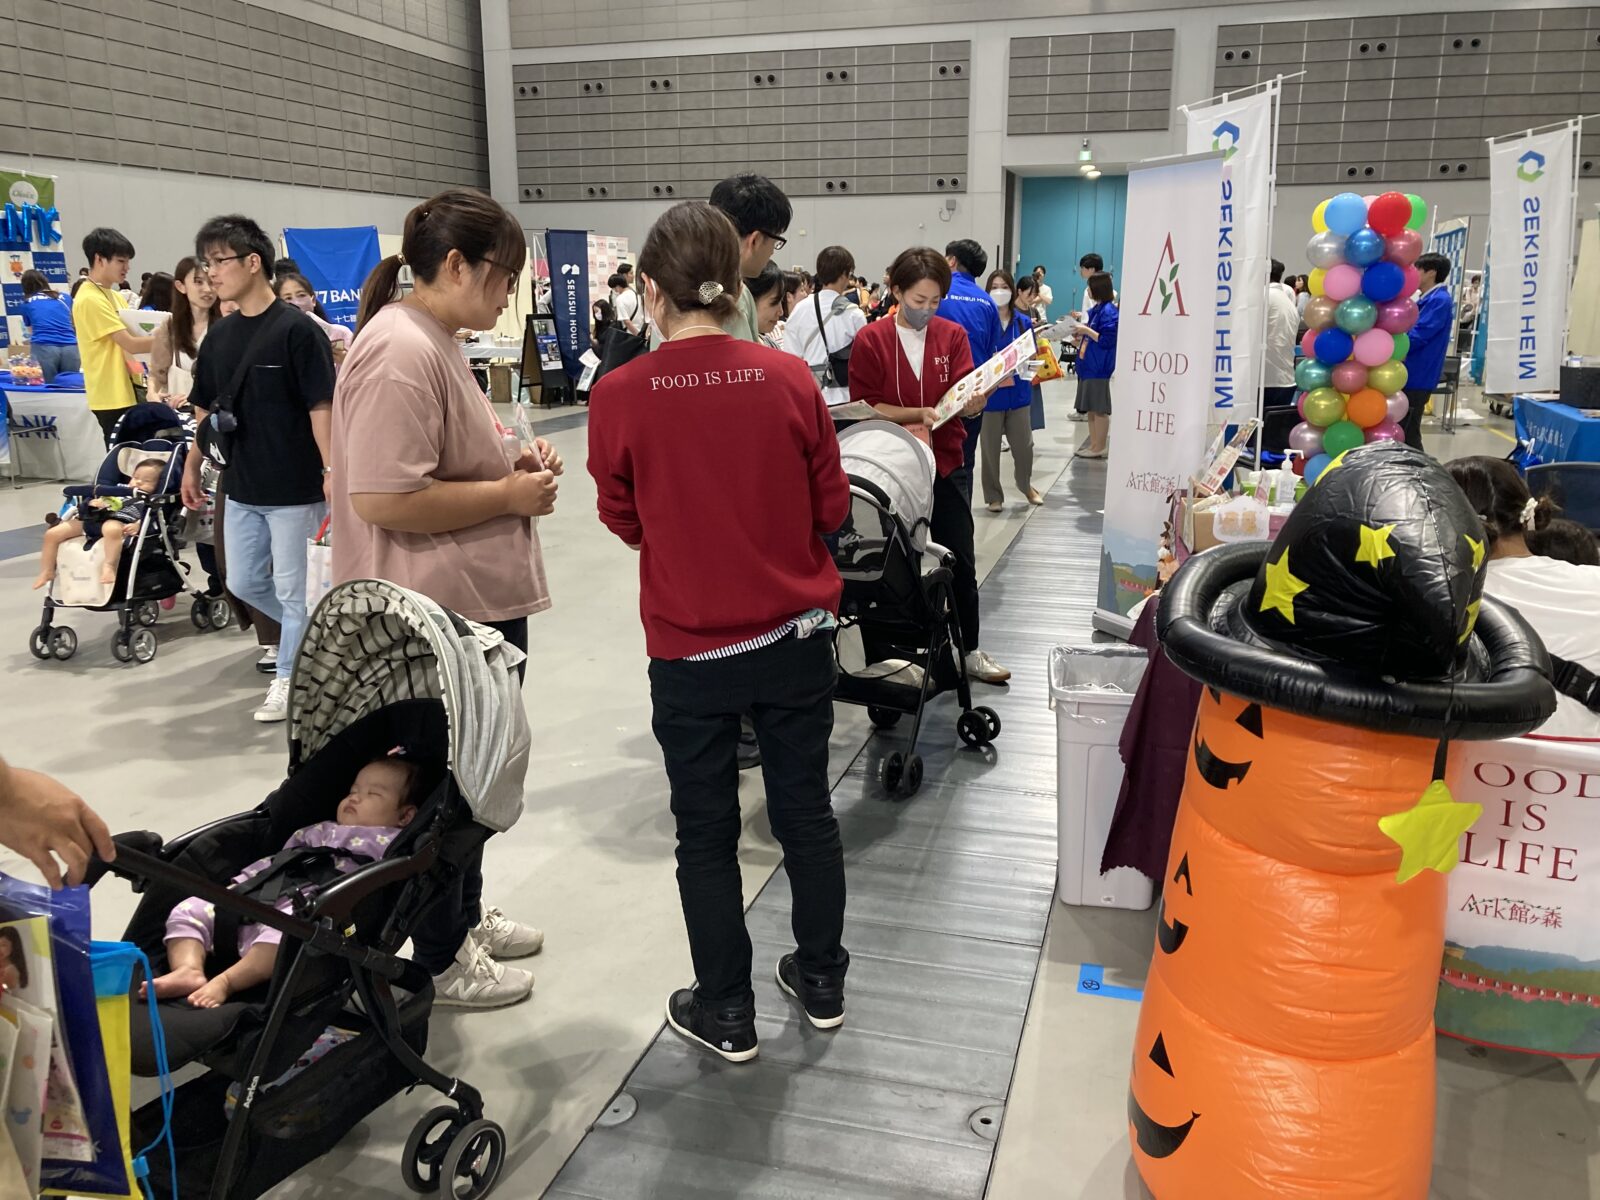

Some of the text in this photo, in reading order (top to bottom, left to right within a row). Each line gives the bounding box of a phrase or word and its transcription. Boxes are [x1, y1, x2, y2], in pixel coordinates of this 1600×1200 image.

[329, 288, 363, 303] BAN
[566, 279, 578, 350] SEKISUI HOUSE
[1132, 350, 1189, 375] FOOD
[650, 368, 765, 391] FOOD IS LIFE
[1150, 382, 1166, 404] IS
[1136, 410, 1176, 435] LIFE
[1473, 761, 1600, 799] OOD
[1499, 798, 1548, 832] IS
[1459, 831, 1579, 882] LIFE
